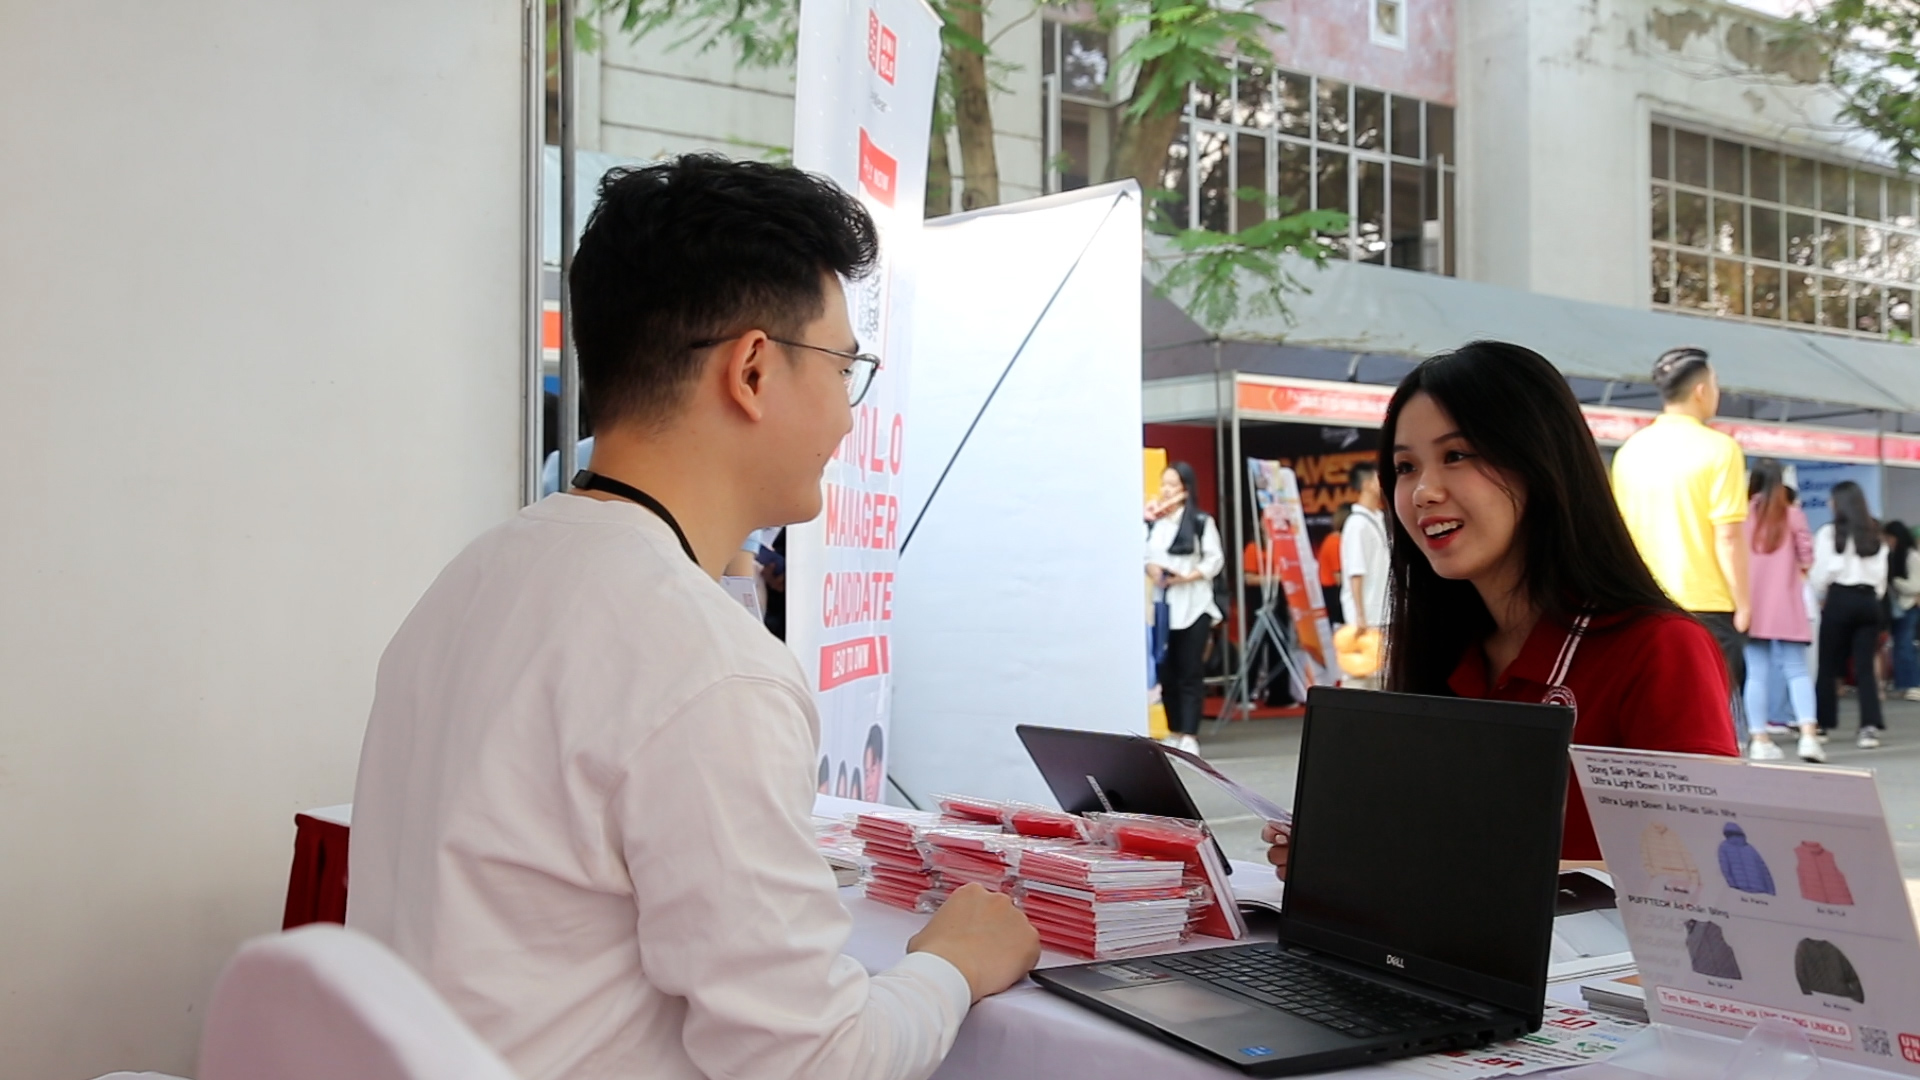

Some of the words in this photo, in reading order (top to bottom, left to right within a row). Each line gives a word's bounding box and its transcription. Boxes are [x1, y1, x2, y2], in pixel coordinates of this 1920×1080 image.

[832, 402, 903, 483] NIQLO
[825, 483, 898, 550] MANAGER
[823, 572, 894, 629] CANDIDATE
[1614, 777, 1635, 790] Light
[1386, 954, 1405, 969] DELL
[1810, 1020, 1847, 1036] UNIQLO
